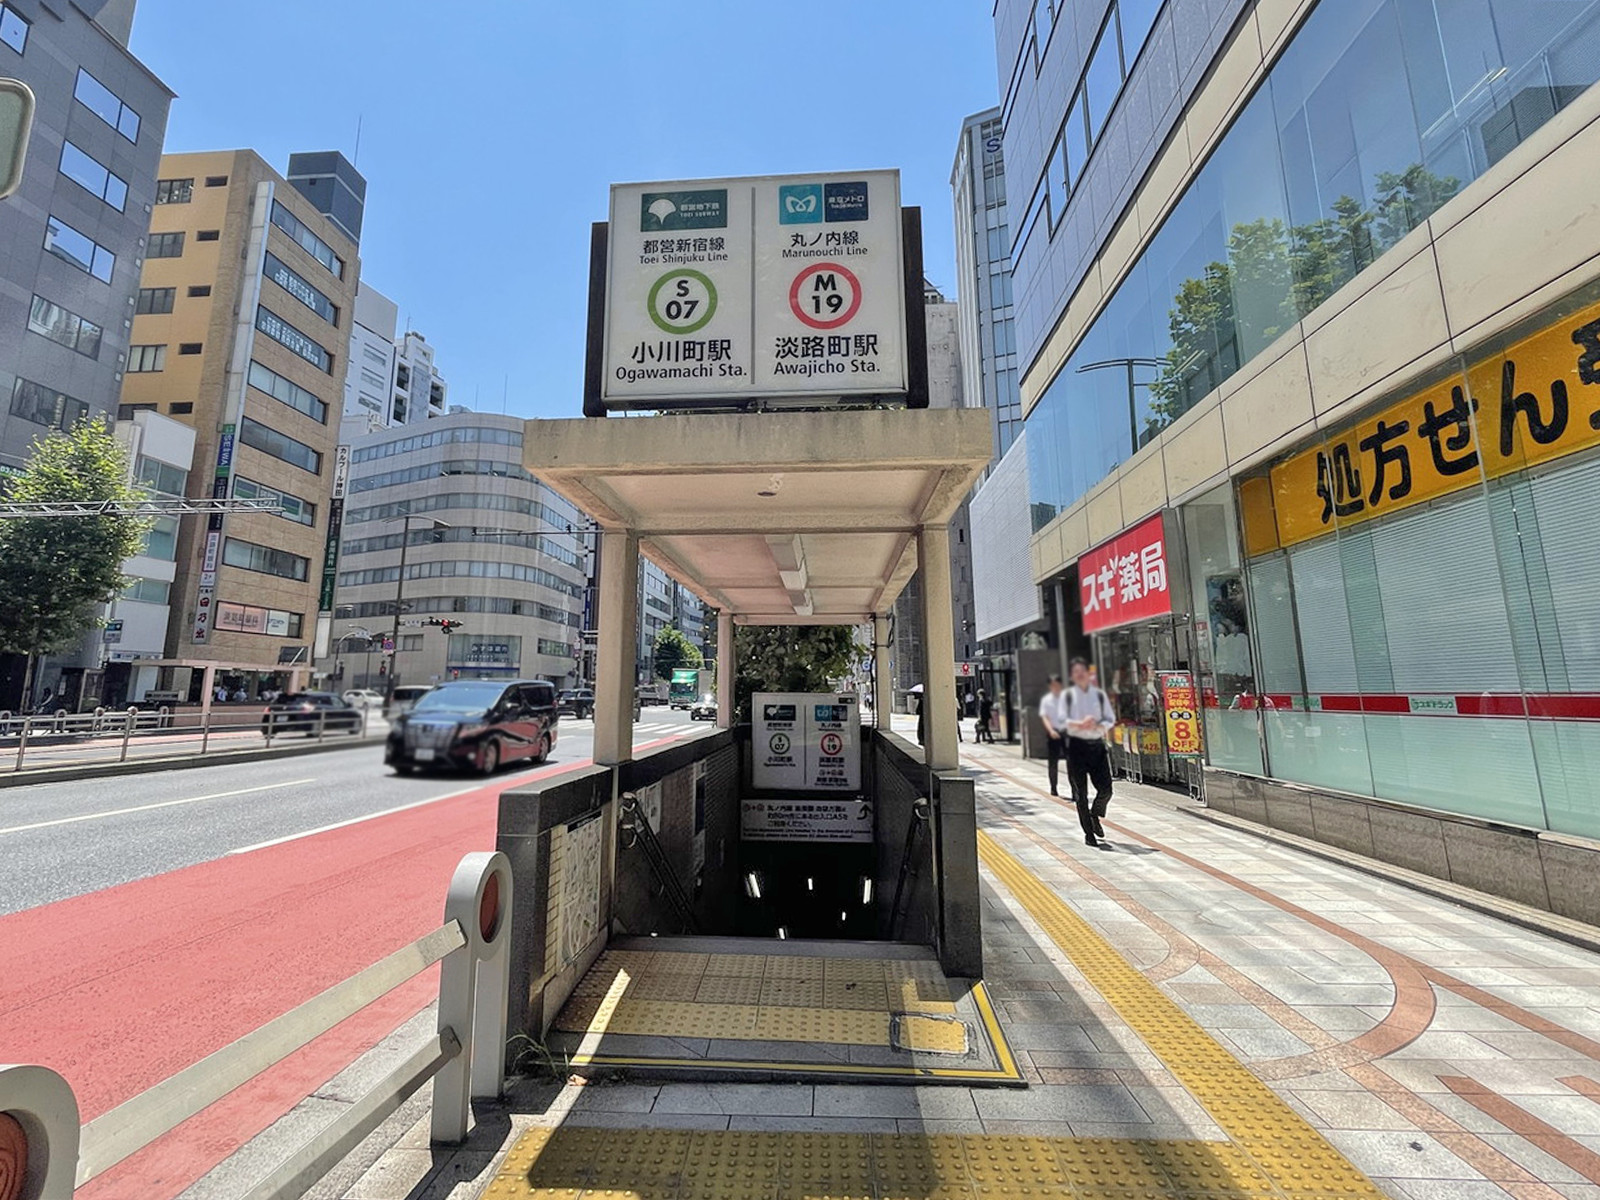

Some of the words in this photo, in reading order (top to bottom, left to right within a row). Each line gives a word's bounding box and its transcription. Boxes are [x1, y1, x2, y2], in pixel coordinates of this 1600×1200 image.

[643, 236, 725, 254] 都営新宿線
[790, 230, 859, 247] 丸ノ内線
[640, 255, 660, 264] Toei
[662, 253, 705, 264] Shinjuku
[708, 252, 728, 261] Line
[782, 247, 844, 258] Marunouchi
[847, 246, 868, 256] Line
[676, 279, 690, 298] S
[813, 273, 838, 292] M
[665, 300, 700, 321] 07
[811, 294, 844, 314] 19
[631, 338, 732, 364] 小川町駅
[775, 334, 879, 359] 淡路町駅
[615, 363, 714, 385] Ogawamachi
[719, 363, 748, 377] Sta.
[774, 360, 846, 378] Awajicho
[850, 359, 881, 374] Sta.
[1082, 540, 1167, 615] スギ薬局
[1172, 740, 1195, 748] OFF
